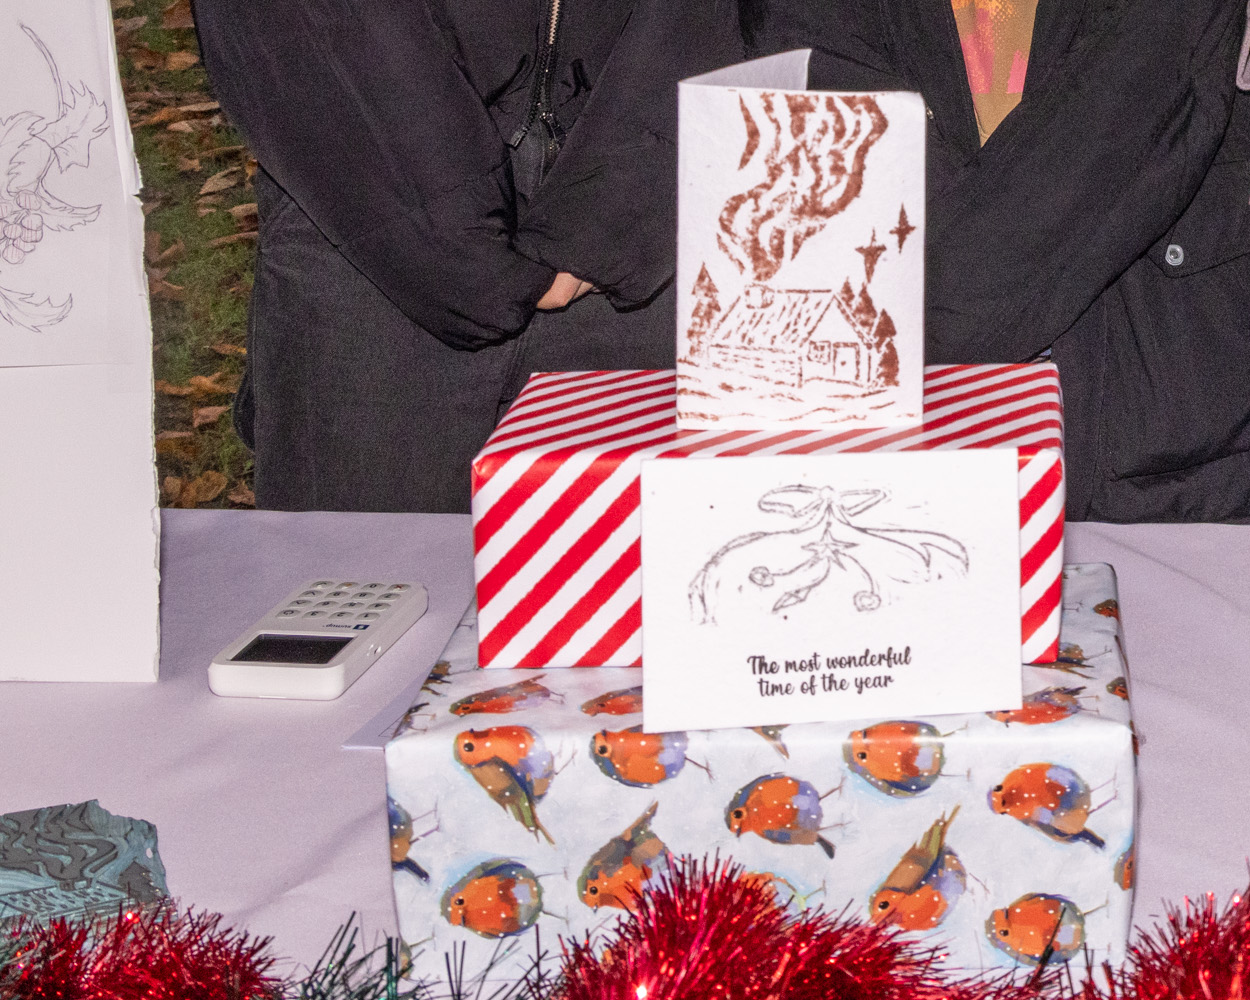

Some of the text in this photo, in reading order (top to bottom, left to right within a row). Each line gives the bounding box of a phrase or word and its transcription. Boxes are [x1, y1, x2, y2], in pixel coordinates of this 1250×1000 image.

[747, 646, 912, 675] The most wonderful
[757, 673, 895, 697] time of the year
